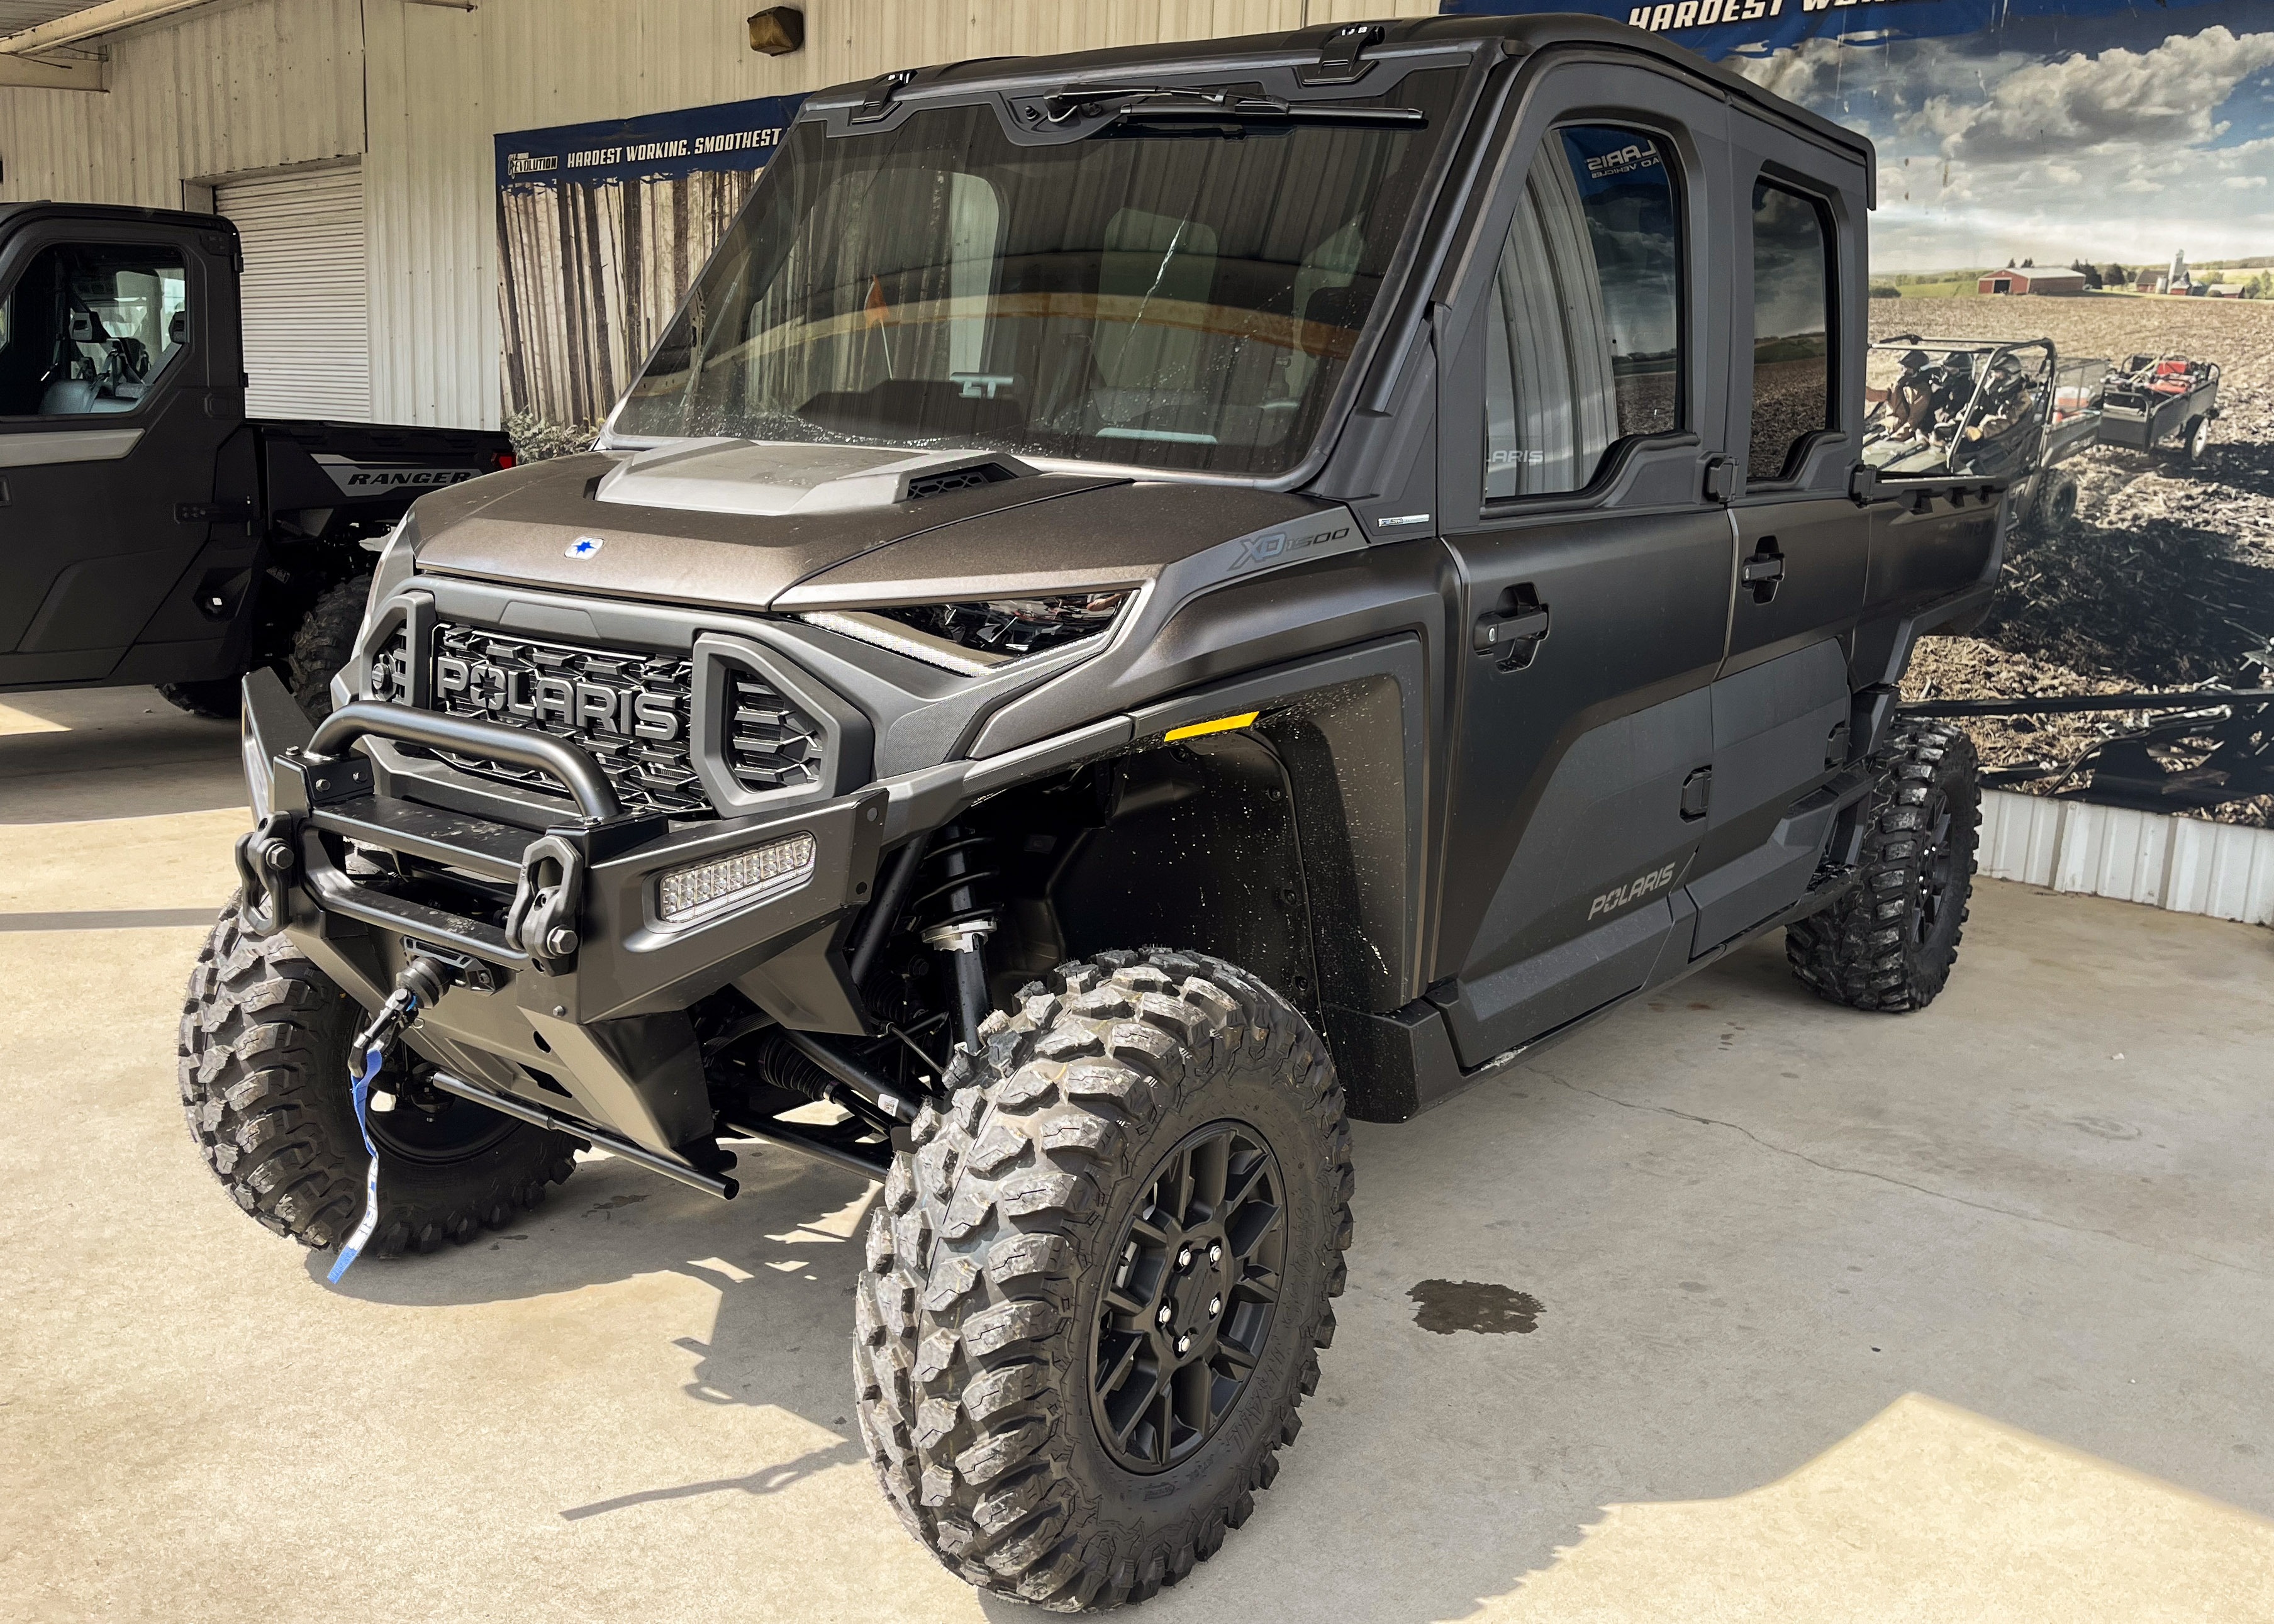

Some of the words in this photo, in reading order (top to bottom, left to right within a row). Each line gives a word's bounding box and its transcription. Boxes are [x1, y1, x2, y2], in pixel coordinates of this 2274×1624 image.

[1629, 0, 1783, 31] HARDEST
[567, 147, 622, 168] HARDEST
[626, 140, 690, 162] WORKING.
[694, 128, 783, 154] SMOOTHEST
[508, 157, 557, 179] REVOLUTION
[1488, 450, 1543, 462] ARIS
[348, 472, 471, 486] RANGER
[438, 657, 681, 741] POLARIS
[1588, 862, 1676, 921] POLARIS
